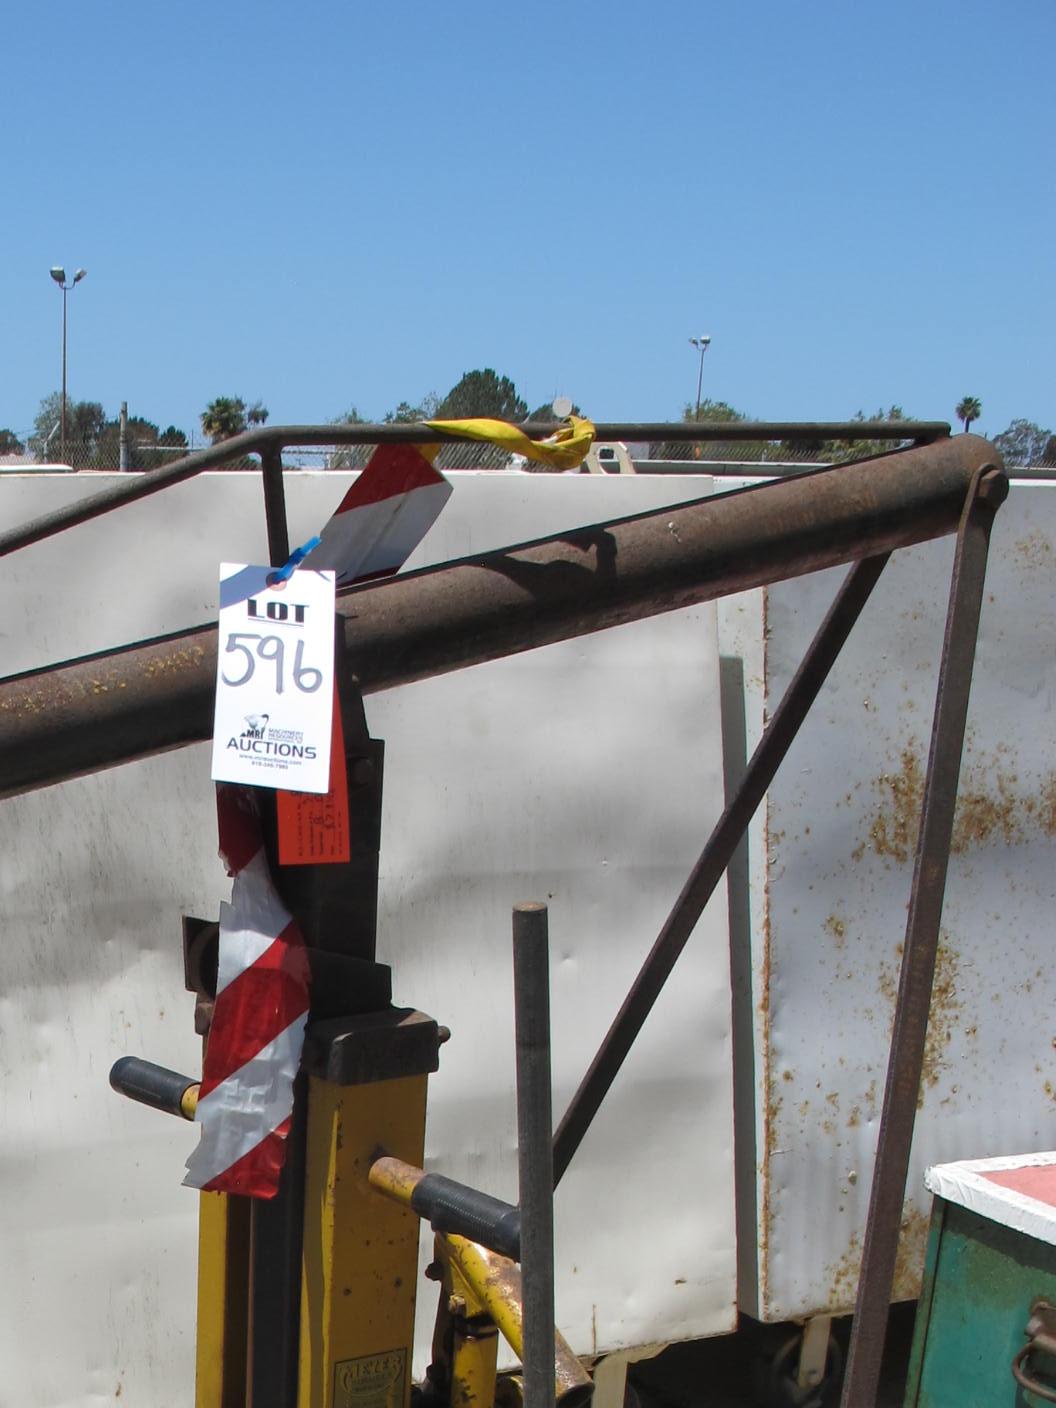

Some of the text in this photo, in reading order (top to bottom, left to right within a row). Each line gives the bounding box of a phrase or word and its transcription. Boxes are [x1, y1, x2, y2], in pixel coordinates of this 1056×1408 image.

[247, 598, 309, 623] LOT
[221, 633, 323, 694] 596
[246, 726, 265, 740] MRI
[226, 737, 317, 760] AUCTIONS
